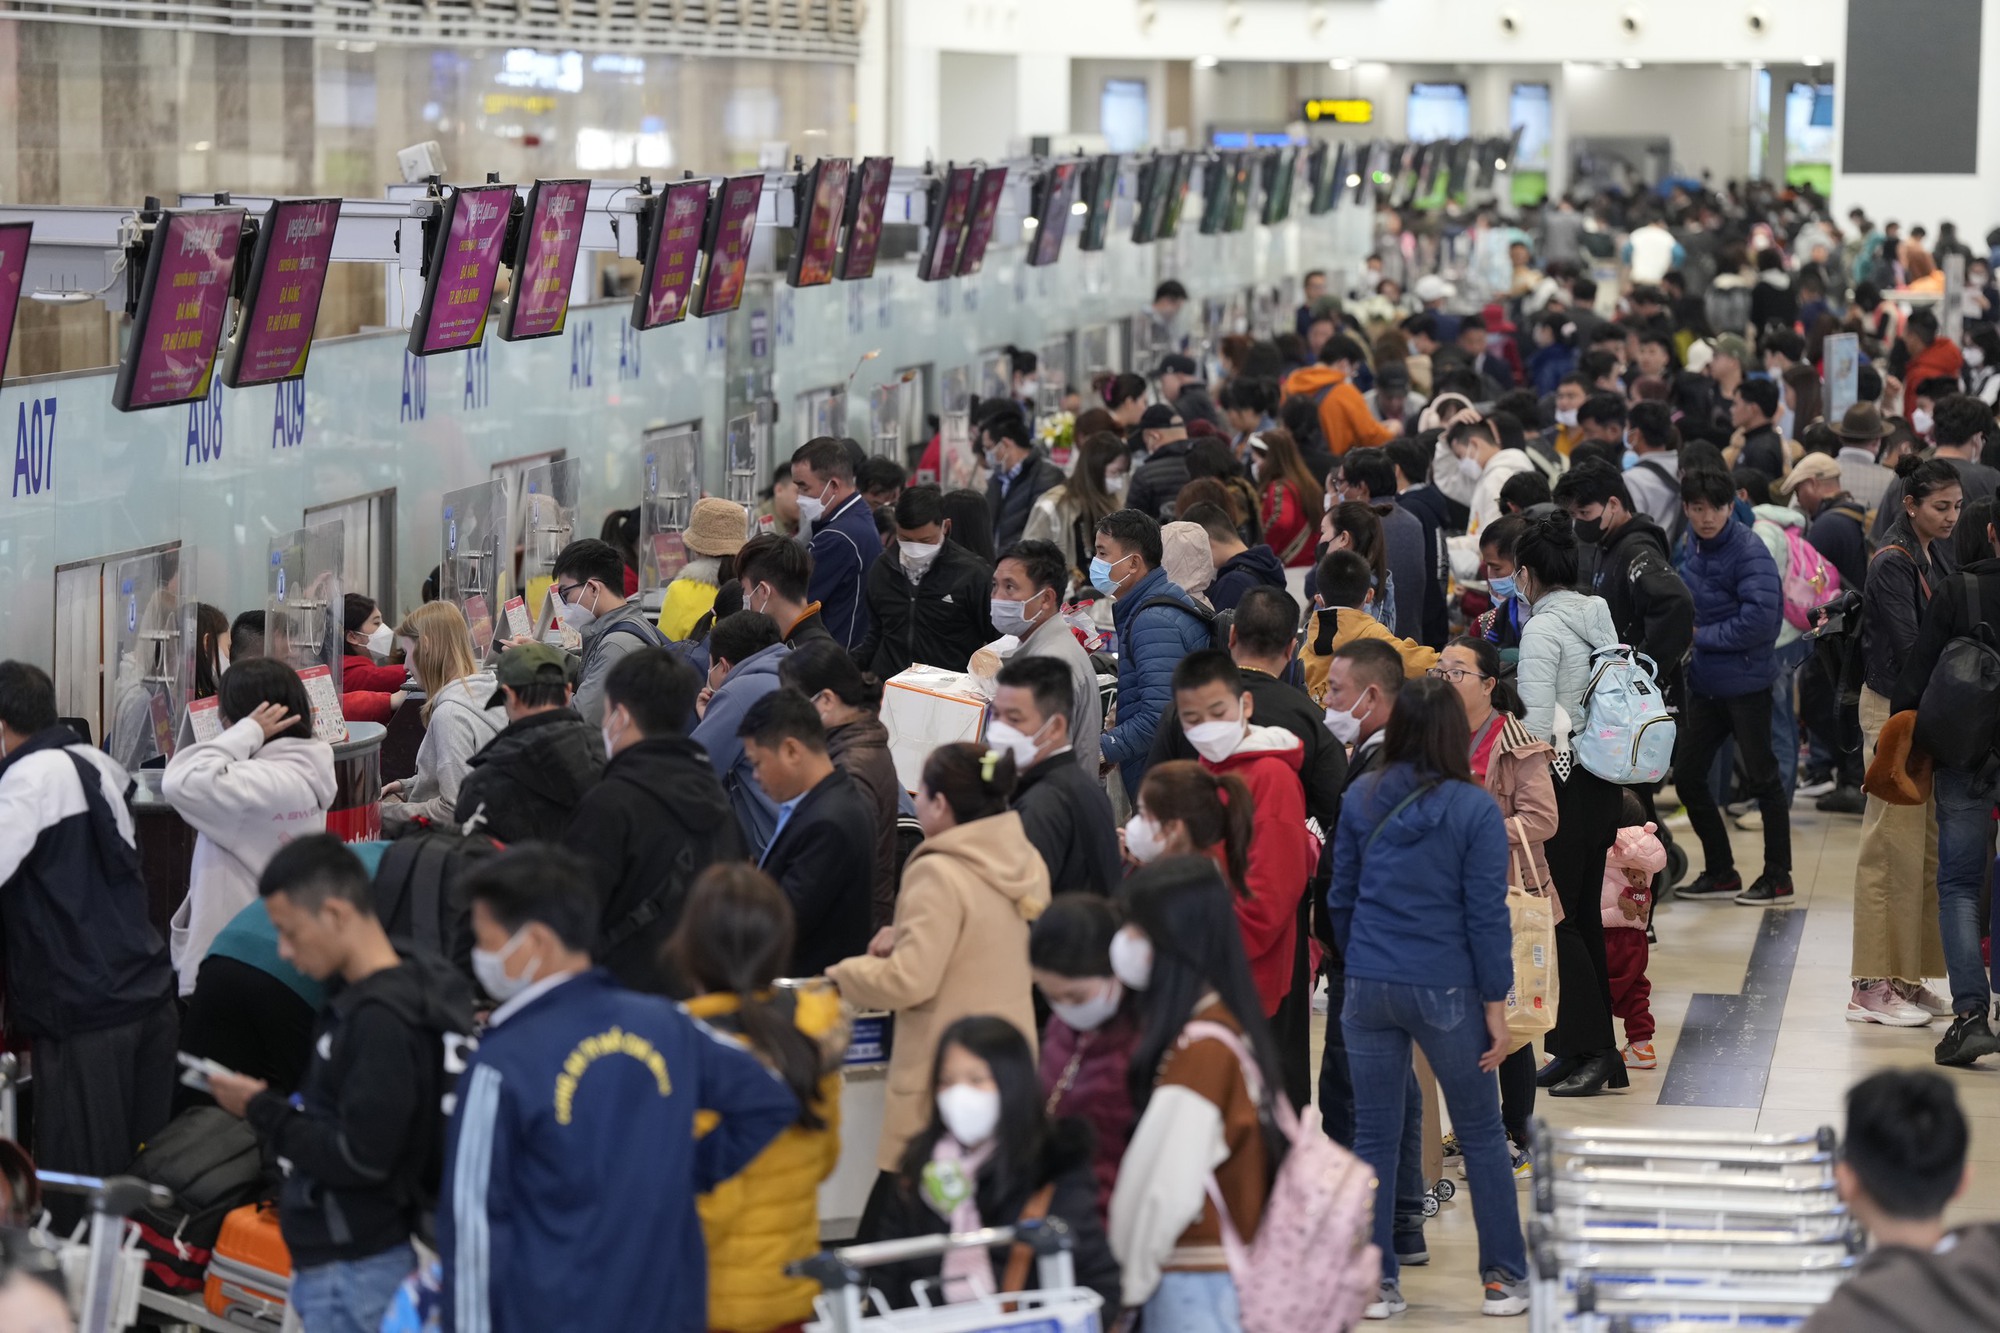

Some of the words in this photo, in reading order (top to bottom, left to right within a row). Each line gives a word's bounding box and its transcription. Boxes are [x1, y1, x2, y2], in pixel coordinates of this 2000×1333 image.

[401, 348, 426, 424] A10
[463, 332, 488, 412] A11
[569, 319, 593, 391] A12
[12, 397, 57, 498] A07
[185, 374, 223, 466] A08
[272, 379, 305, 449] A09
